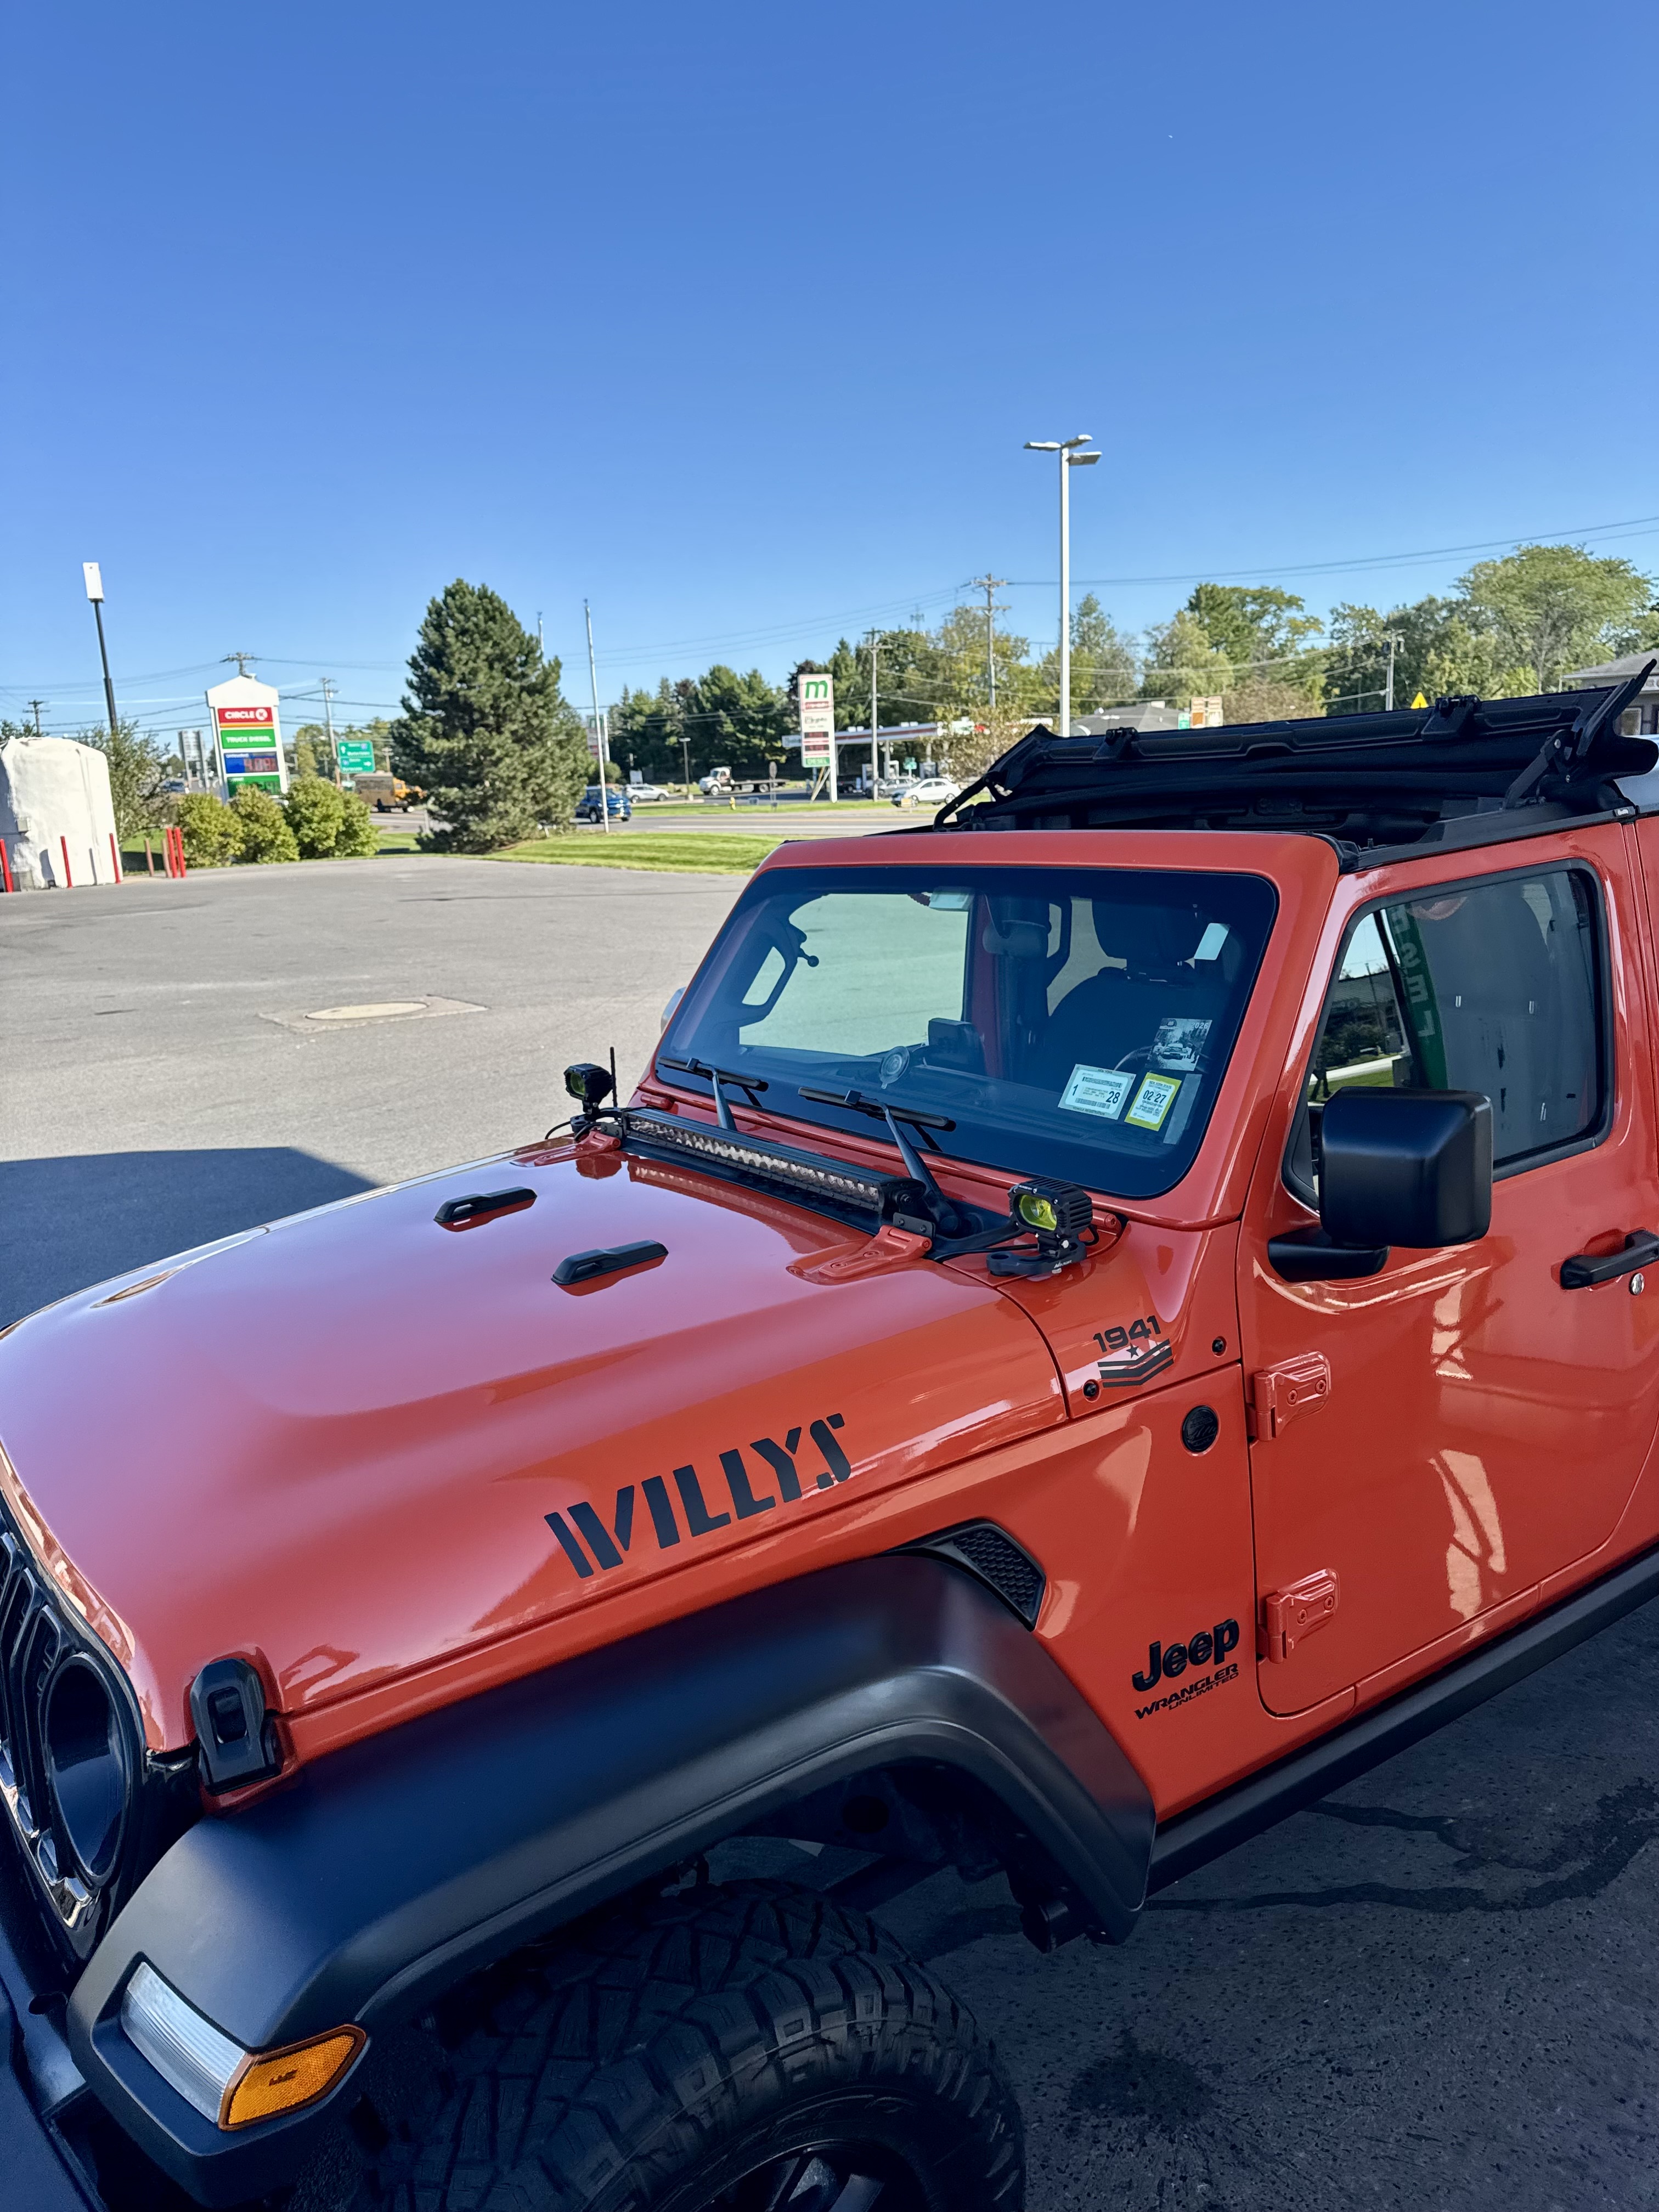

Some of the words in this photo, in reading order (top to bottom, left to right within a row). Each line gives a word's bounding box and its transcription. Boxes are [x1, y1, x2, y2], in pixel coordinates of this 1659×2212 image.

[224, 710, 255, 719] CIRCLE
[256, 708, 268, 721] K
[1072, 1084, 1079, 1096] 1
[1105, 1091, 1120, 1104] 28
[1143, 1090, 1154, 1101] 02
[1154, 1093, 1166, 1104] 27
[1093, 1315, 1161, 1353] 1941
[544, 1413, 851, 1579] WILLYS
[1132, 1618, 1240, 1692] Jeep
[1134, 1663, 1239, 1719] WRANGLER
[1168, 1672, 1239, 1711] UNLIMITED
